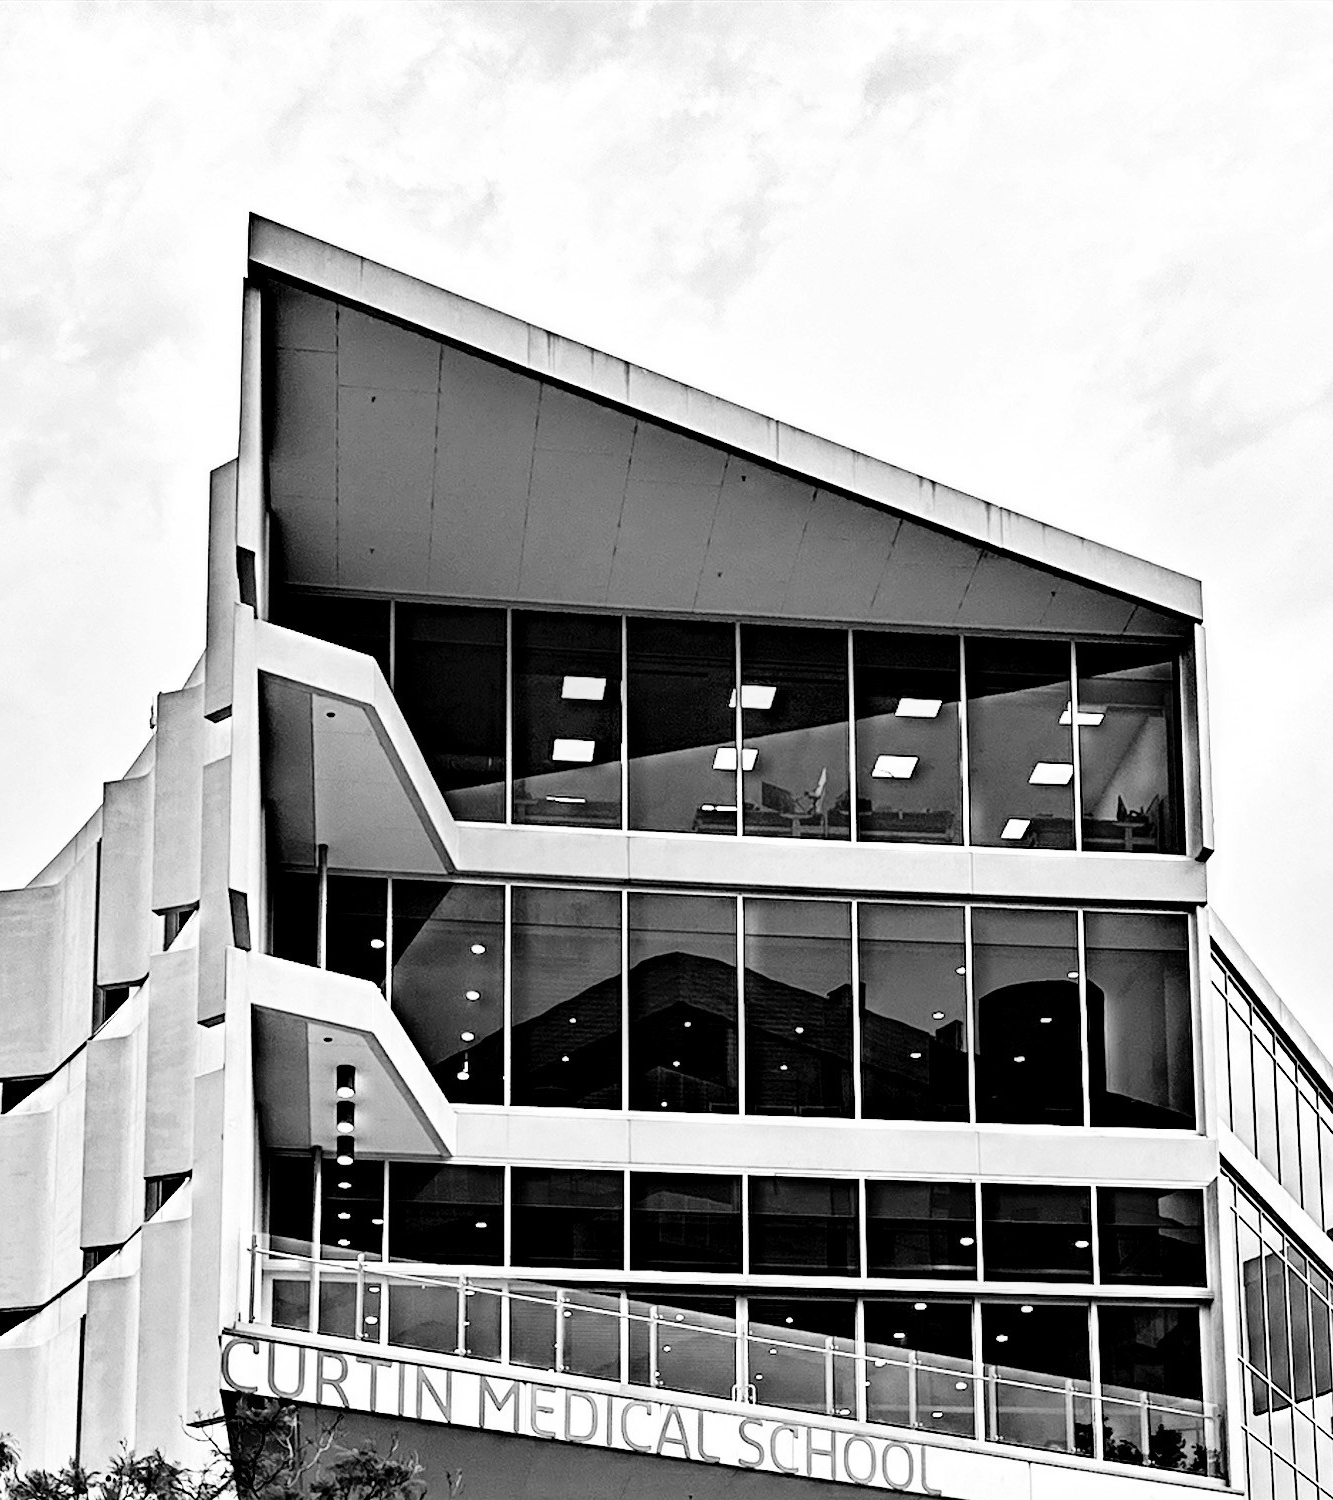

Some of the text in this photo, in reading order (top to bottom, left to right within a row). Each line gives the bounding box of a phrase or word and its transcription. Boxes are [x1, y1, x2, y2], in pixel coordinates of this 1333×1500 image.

[220, 1336, 943, 1497] CURTIN MEDICAL SCHOOL
